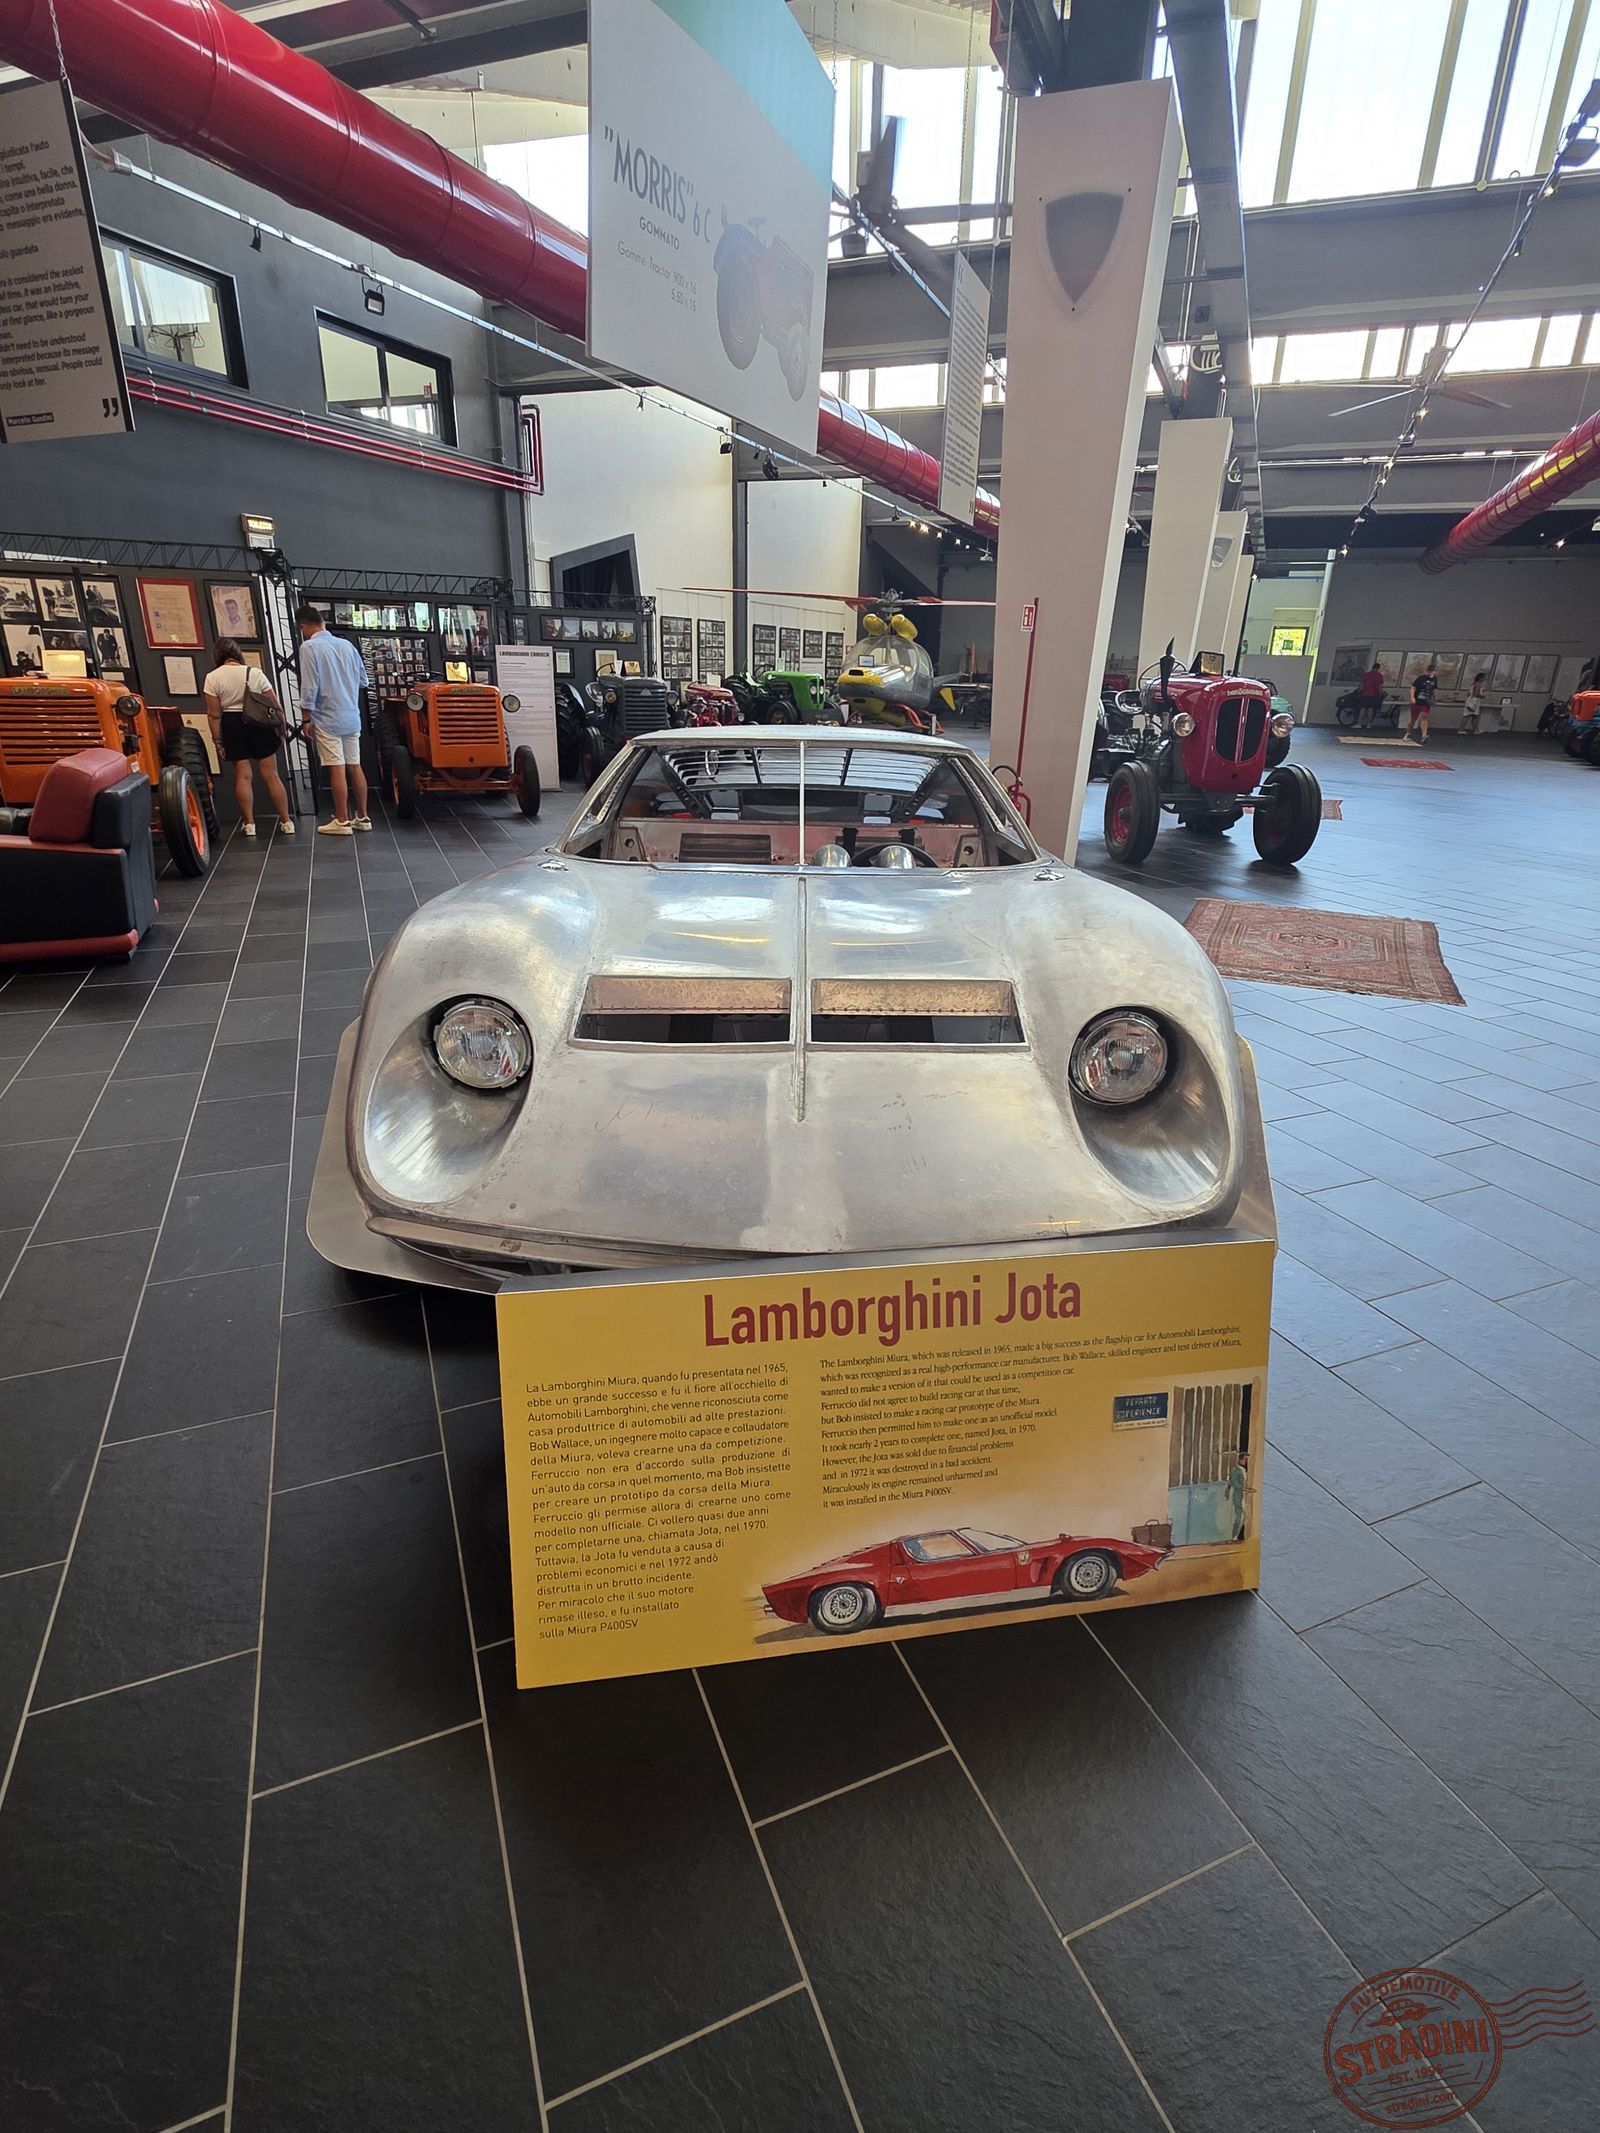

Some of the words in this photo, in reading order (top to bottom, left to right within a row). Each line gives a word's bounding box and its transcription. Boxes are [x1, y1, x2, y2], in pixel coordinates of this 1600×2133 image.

[60, 164, 73, 175] che
[36, 184, 53, 195] bella
[41, 214, 53, 223] era
[692, 200, 700, 237] 6
[704, 207, 712, 244] C
[638, 216, 680, 251] GOMMATO
[617, 240, 647, 266] Gomme
[50, 269, 60, 279] the
[73, 293, 89, 304] your
[704, 1275, 981, 1346] Lamborghini
[994, 1272, 1080, 1323] Jota
[819, 1359, 835, 1368] The
[837, 1355, 884, 1367] Lamborghini
[911, 1350, 934, 1360] which
[951, 1346, 982, 1357] released
[1013, 1342, 1034, 1352] made
[1041, 1341, 1053, 1351] big
[1054, 1340, 1081, 1348] success
[1092, 1336, 1104, 1345] the
[1105, 1334, 1132, 1345] flagship
[1146, 1332, 1156, 1340] for
[1157, 1329, 1195, 1339] Automobili
[526, 1383, 539, 1393] La
[541, 1378, 605, 1392] Lamborghini
[607, 1376, 639, 1386] Miura,
[641, 1372, 678, 1385] quando
[680, 1370, 690, 1380] fu
[692, 1367, 744, 1381] presentata
[745, 1364, 761, 1375] nel
[764, 1362, 788, 1373] 1965,
[526, 1397, 552, 1408] ebbe
[555, 1397, 569, 1405] un
[572, 1392, 608, 1406] grande
[611, 1390, 658, 1400] successo
[671, 1385, 681, 1395] fu
[684, 1385, 691, 1394] il
[694, 1384, 716, 1393] fiore
[719, 1377, 776, 1392] all'occhiello
[779, 1376, 788, 1386] di
[527, 1408, 582, 1422] Automobili
[584, 1404, 649, 1418] Lamborghini,
[651, 1401, 669, 1412] che
[670, 1400, 700, 1410] venne
[702, 1394, 760, 1407] riconosciuta
[762, 1393, 789, 1402] come
[820, 1399, 857, 1411] Ferruccio
[858, 1397, 871, 1407] did
[872, 1398, 886, 1406] not
[887, 1396, 908, 1406] agree
[909, 1395, 918, 1403] to
[919, 1391, 938, 1402] build
[940, 1391, 963, 1400] racing
[985, 1386, 1000, 1395] that
[1001, 1386, 1020, 1394] time,
[528, 1428, 553, 1437] casa
[556, 1422, 615, 1436] produttrice
[618, 1419, 628, 1429] di
[631, 1414, 686, 1428] automobili
[689, 1412, 702, 1423] ad
[704, 1411, 724, 1421] alte
[727, 1407, 785, 1422] prestazioni.
[529, 1441, 549, 1451] Bob
[550, 1439, 592, 1449] Wallace,
[594, 1437, 607, 1446] un
[609, 1433, 657, 1446] ingegnere
[659, 1429, 687, 1439] molto
[688, 1427, 722, 1438] capace
[724, 1426, 730, 1434] e
[732, 1421, 789, 1433] collaudatore
[530, 1455, 557, 1466] della
[560, 1452, 594, 1463] Miura,
[597, 1449, 630, 1460] voleva
[633, 1446, 674, 1456] crearne
[677, 1444, 697, 1453] una
[699, 1441, 712, 1450] da
[715, 1436, 785, 1449] competizione.
[823, 1499, 828, 1508] it
[845, 1494, 877, 1505] installed
[878, 1494, 886, 1502] in
[887, 1492, 901, 1501] the
[901, 1490, 923, 1500] Miura
[539, 1628, 564, 1639] sulla
[567, 1625, 597, 1635] Miura
[600, 1618, 638, 1631] P400SV
